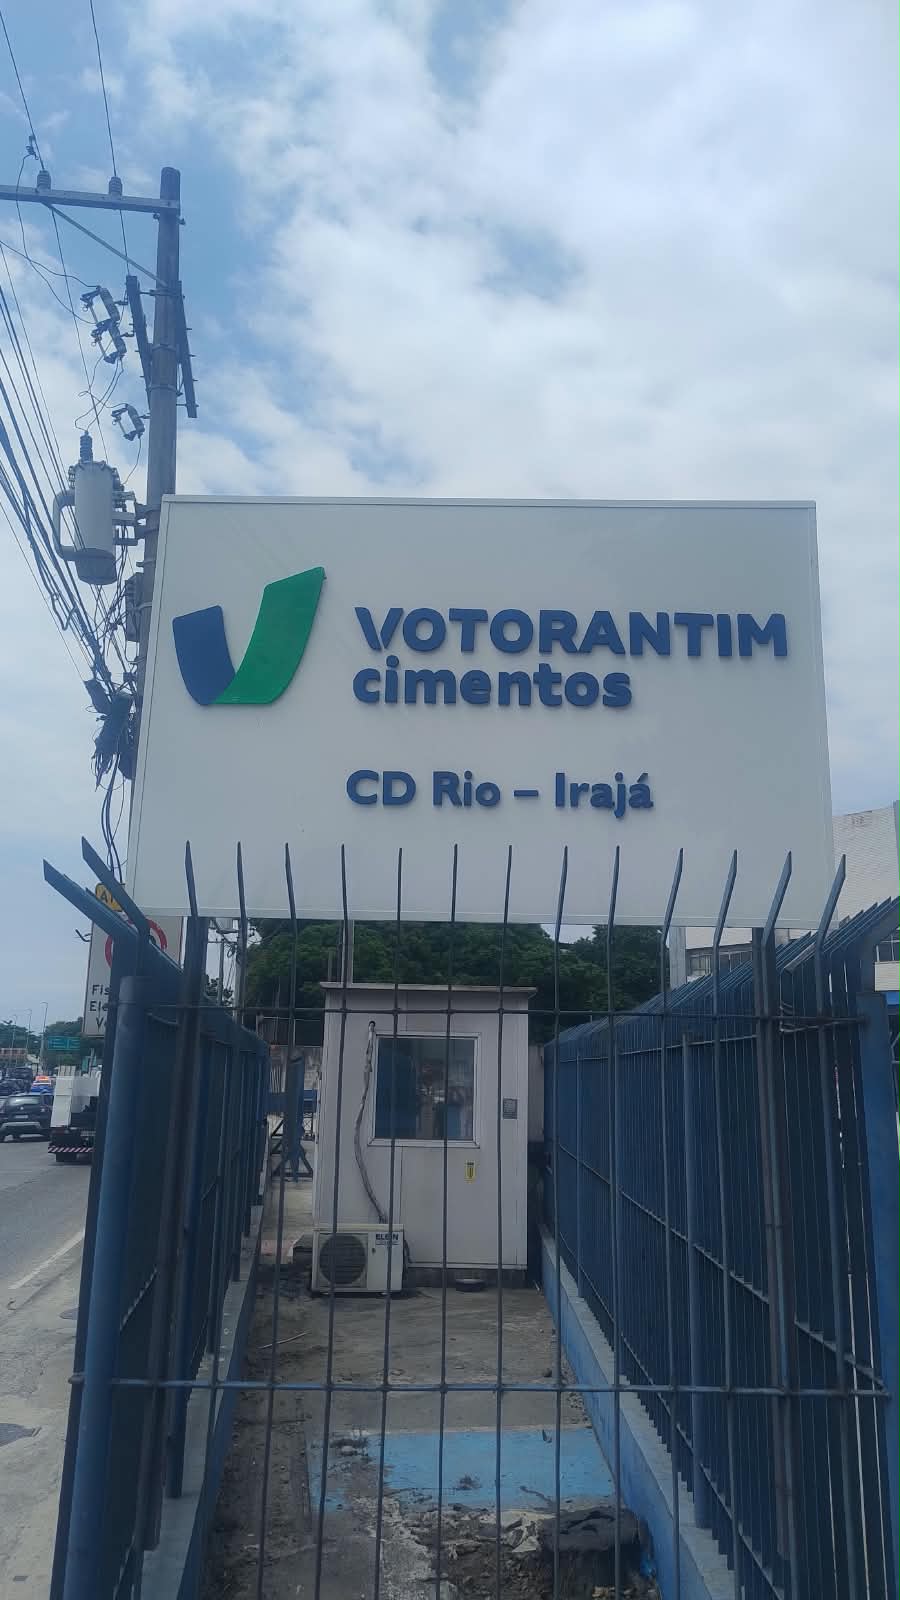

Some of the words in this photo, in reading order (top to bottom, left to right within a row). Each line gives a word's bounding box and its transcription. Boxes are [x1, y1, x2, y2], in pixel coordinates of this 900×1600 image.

[355, 607, 789, 658] VOTORANTIM
[353, 655, 633, 707] cimentos
[346, 770, 416, 807] CD
[433, 770, 502, 808] Rio
[555, 772, 654, 819] Irajá
